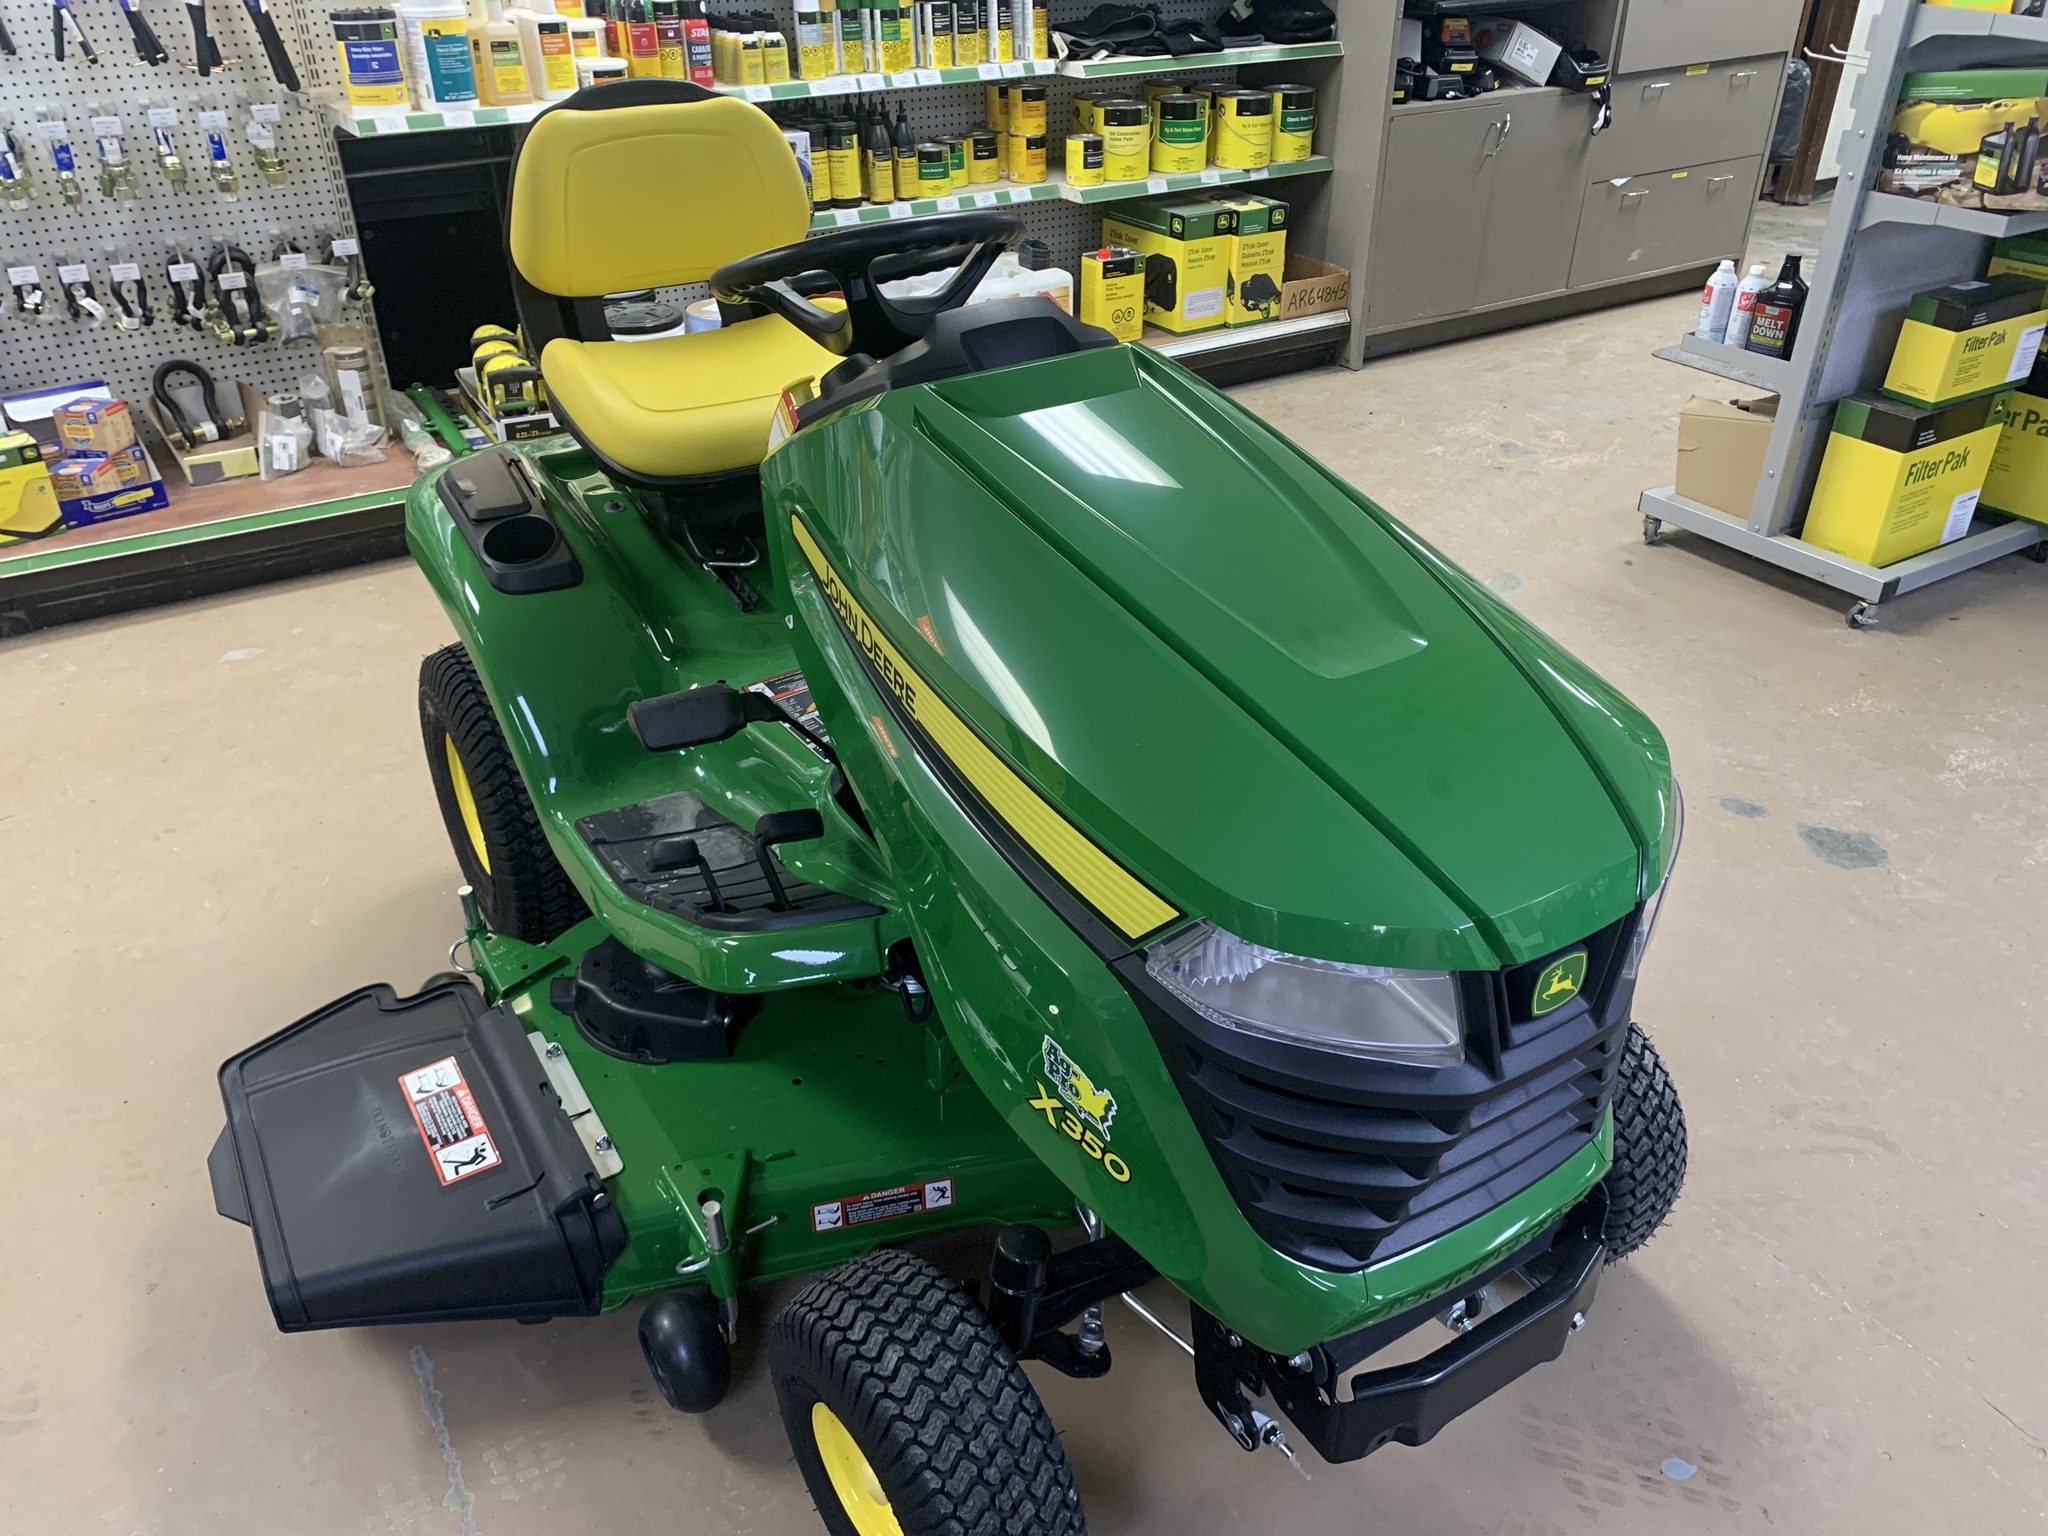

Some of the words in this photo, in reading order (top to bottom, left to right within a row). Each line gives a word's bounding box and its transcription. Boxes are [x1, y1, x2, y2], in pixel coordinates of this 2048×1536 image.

[1287, 282, 1348, 311] AR64845
[1753, 326, 1783, 339] DOWN
[1756, 317, 1784, 329] MELT
[823, 565, 858, 636] JOHN
[861, 618, 916, 715] DEERE
[461, 1096, 484, 1130] DANGER
[1025, 1075, 1132, 1183] X350
[871, 1187, 905, 1199] DANGER
